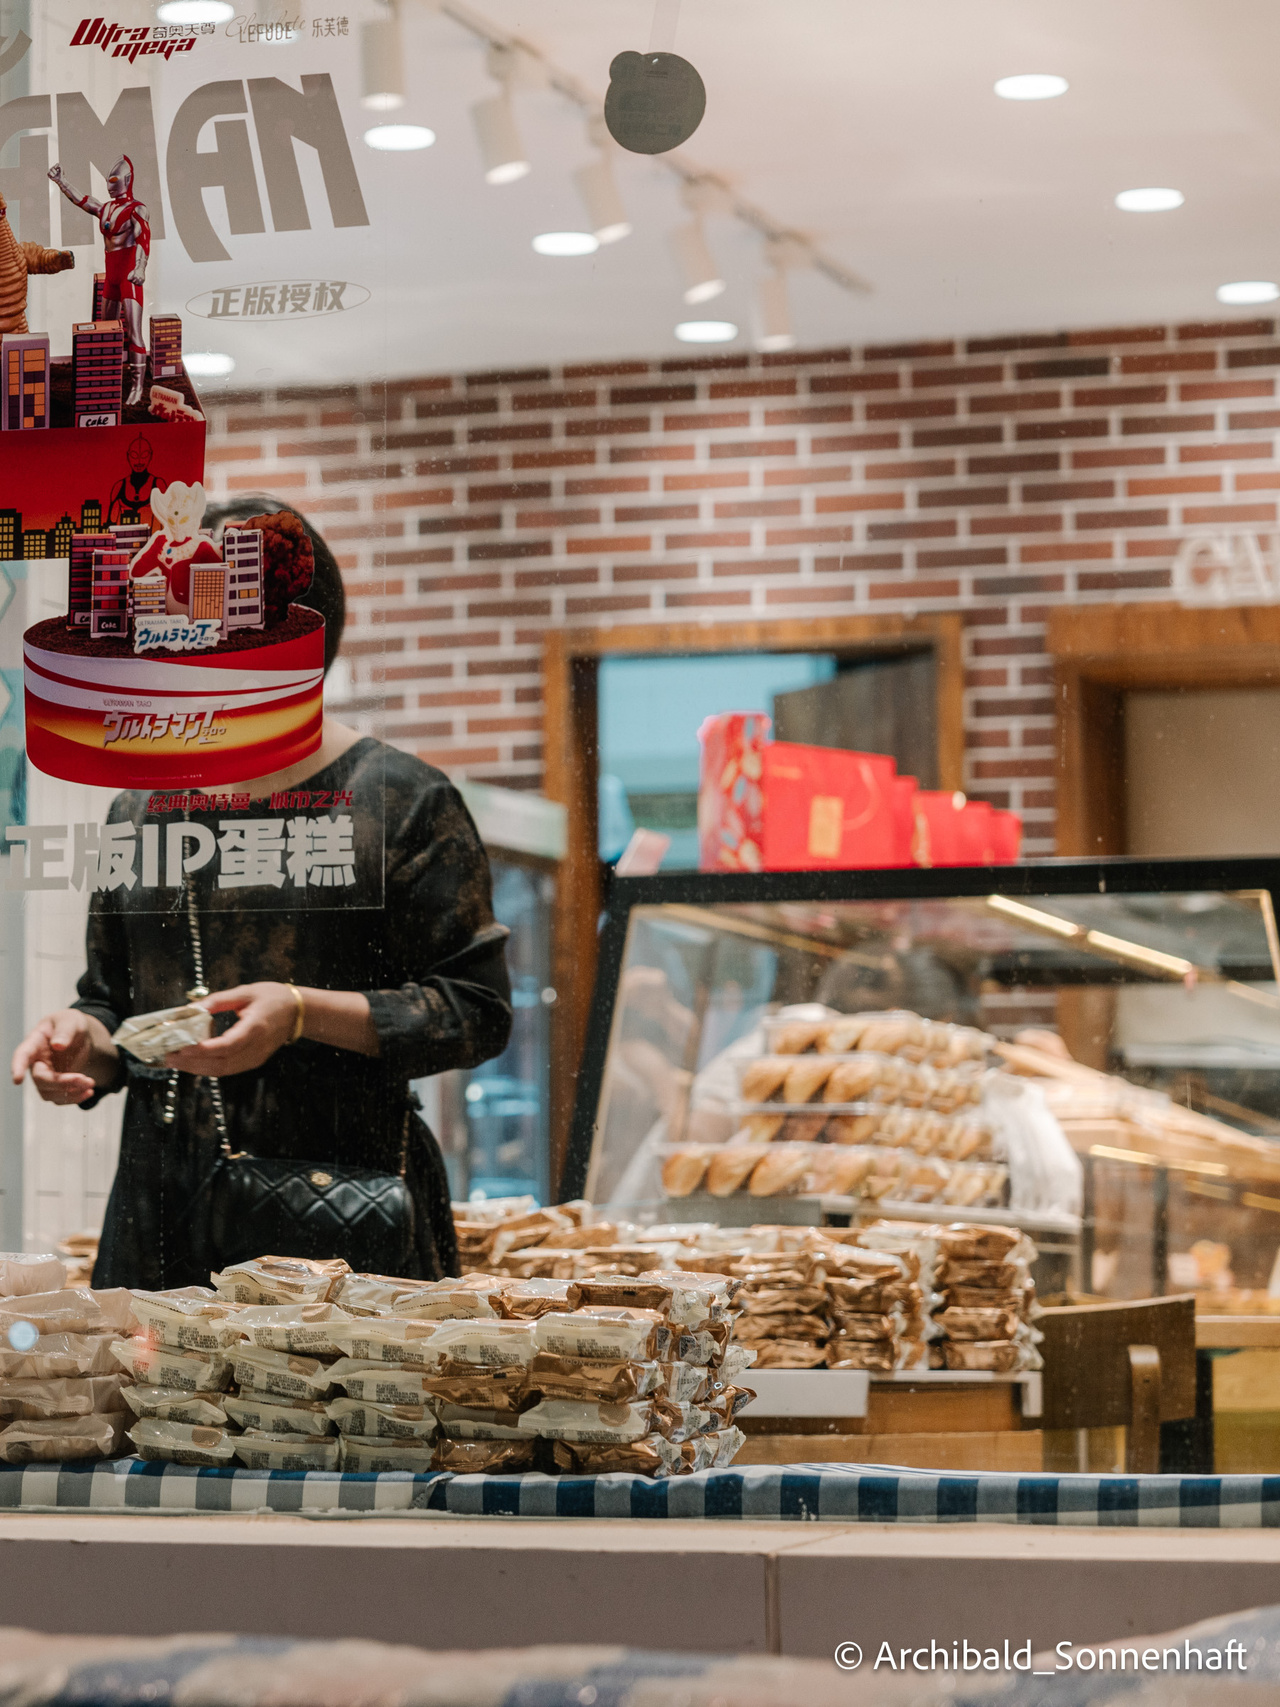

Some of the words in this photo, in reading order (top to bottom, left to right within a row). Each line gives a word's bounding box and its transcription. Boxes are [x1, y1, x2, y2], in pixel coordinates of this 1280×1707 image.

[69, 17, 151, 52] Ultra
[152, 21, 216, 39] 奇奥天尊
[239, 21, 293, 44] LEFUDE
[311, 16, 349, 38] 乐芙德
[111, 37, 197, 65] mega
[206, 282, 348, 319] 正版授权
